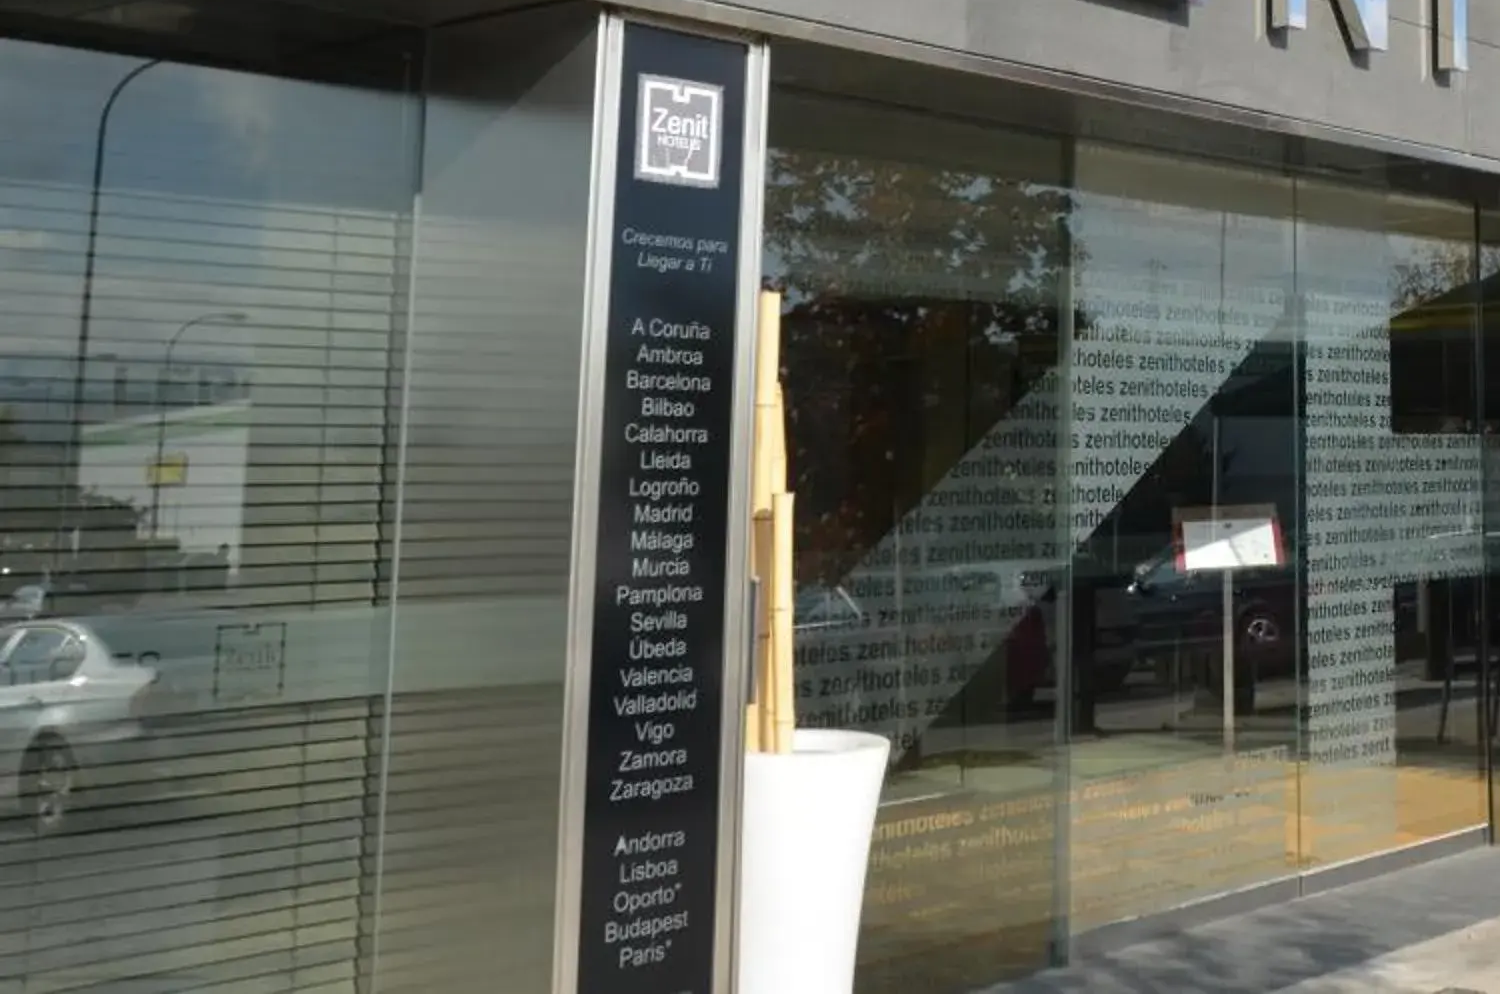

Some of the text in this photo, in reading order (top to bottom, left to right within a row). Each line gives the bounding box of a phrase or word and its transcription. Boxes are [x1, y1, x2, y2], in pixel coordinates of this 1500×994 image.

[652, 108, 709, 139] Zenit
[621, 228, 729, 255] Crecemos para
[637, 251, 682, 274] Llegar
[685, 261, 695, 271] a
[631, 318, 711, 340] A Coruña
[636, 345, 704, 366] Ambroa
[626, 370, 712, 392] Barcelona
[641, 396, 695, 418] Bilbao
[624, 423, 709, 444] Calahorra
[640, 451, 692, 470] Lleida
[628, 478, 700, 500] Logroño
[633, 504, 693, 523] Madrid
[630, 531, 694, 553] Málaga
[631, 557, 690, 578] Murcia
[616, 584, 703, 606] Pamplona
[630, 611, 687, 633] Sevilla
[629, 636, 687, 659] Úbeda
[620, 664, 693, 688] Valencia
[613, 689, 697, 716] Valladolid
[634, 719, 675, 745] Vigo
[619, 747, 688, 772] Zamora
[609, 774, 694, 802] Zaragoza
[614, 829, 685, 856] Andorra
[619, 859, 679, 884] Lisboa
[604, 910, 689, 943] Budapest
